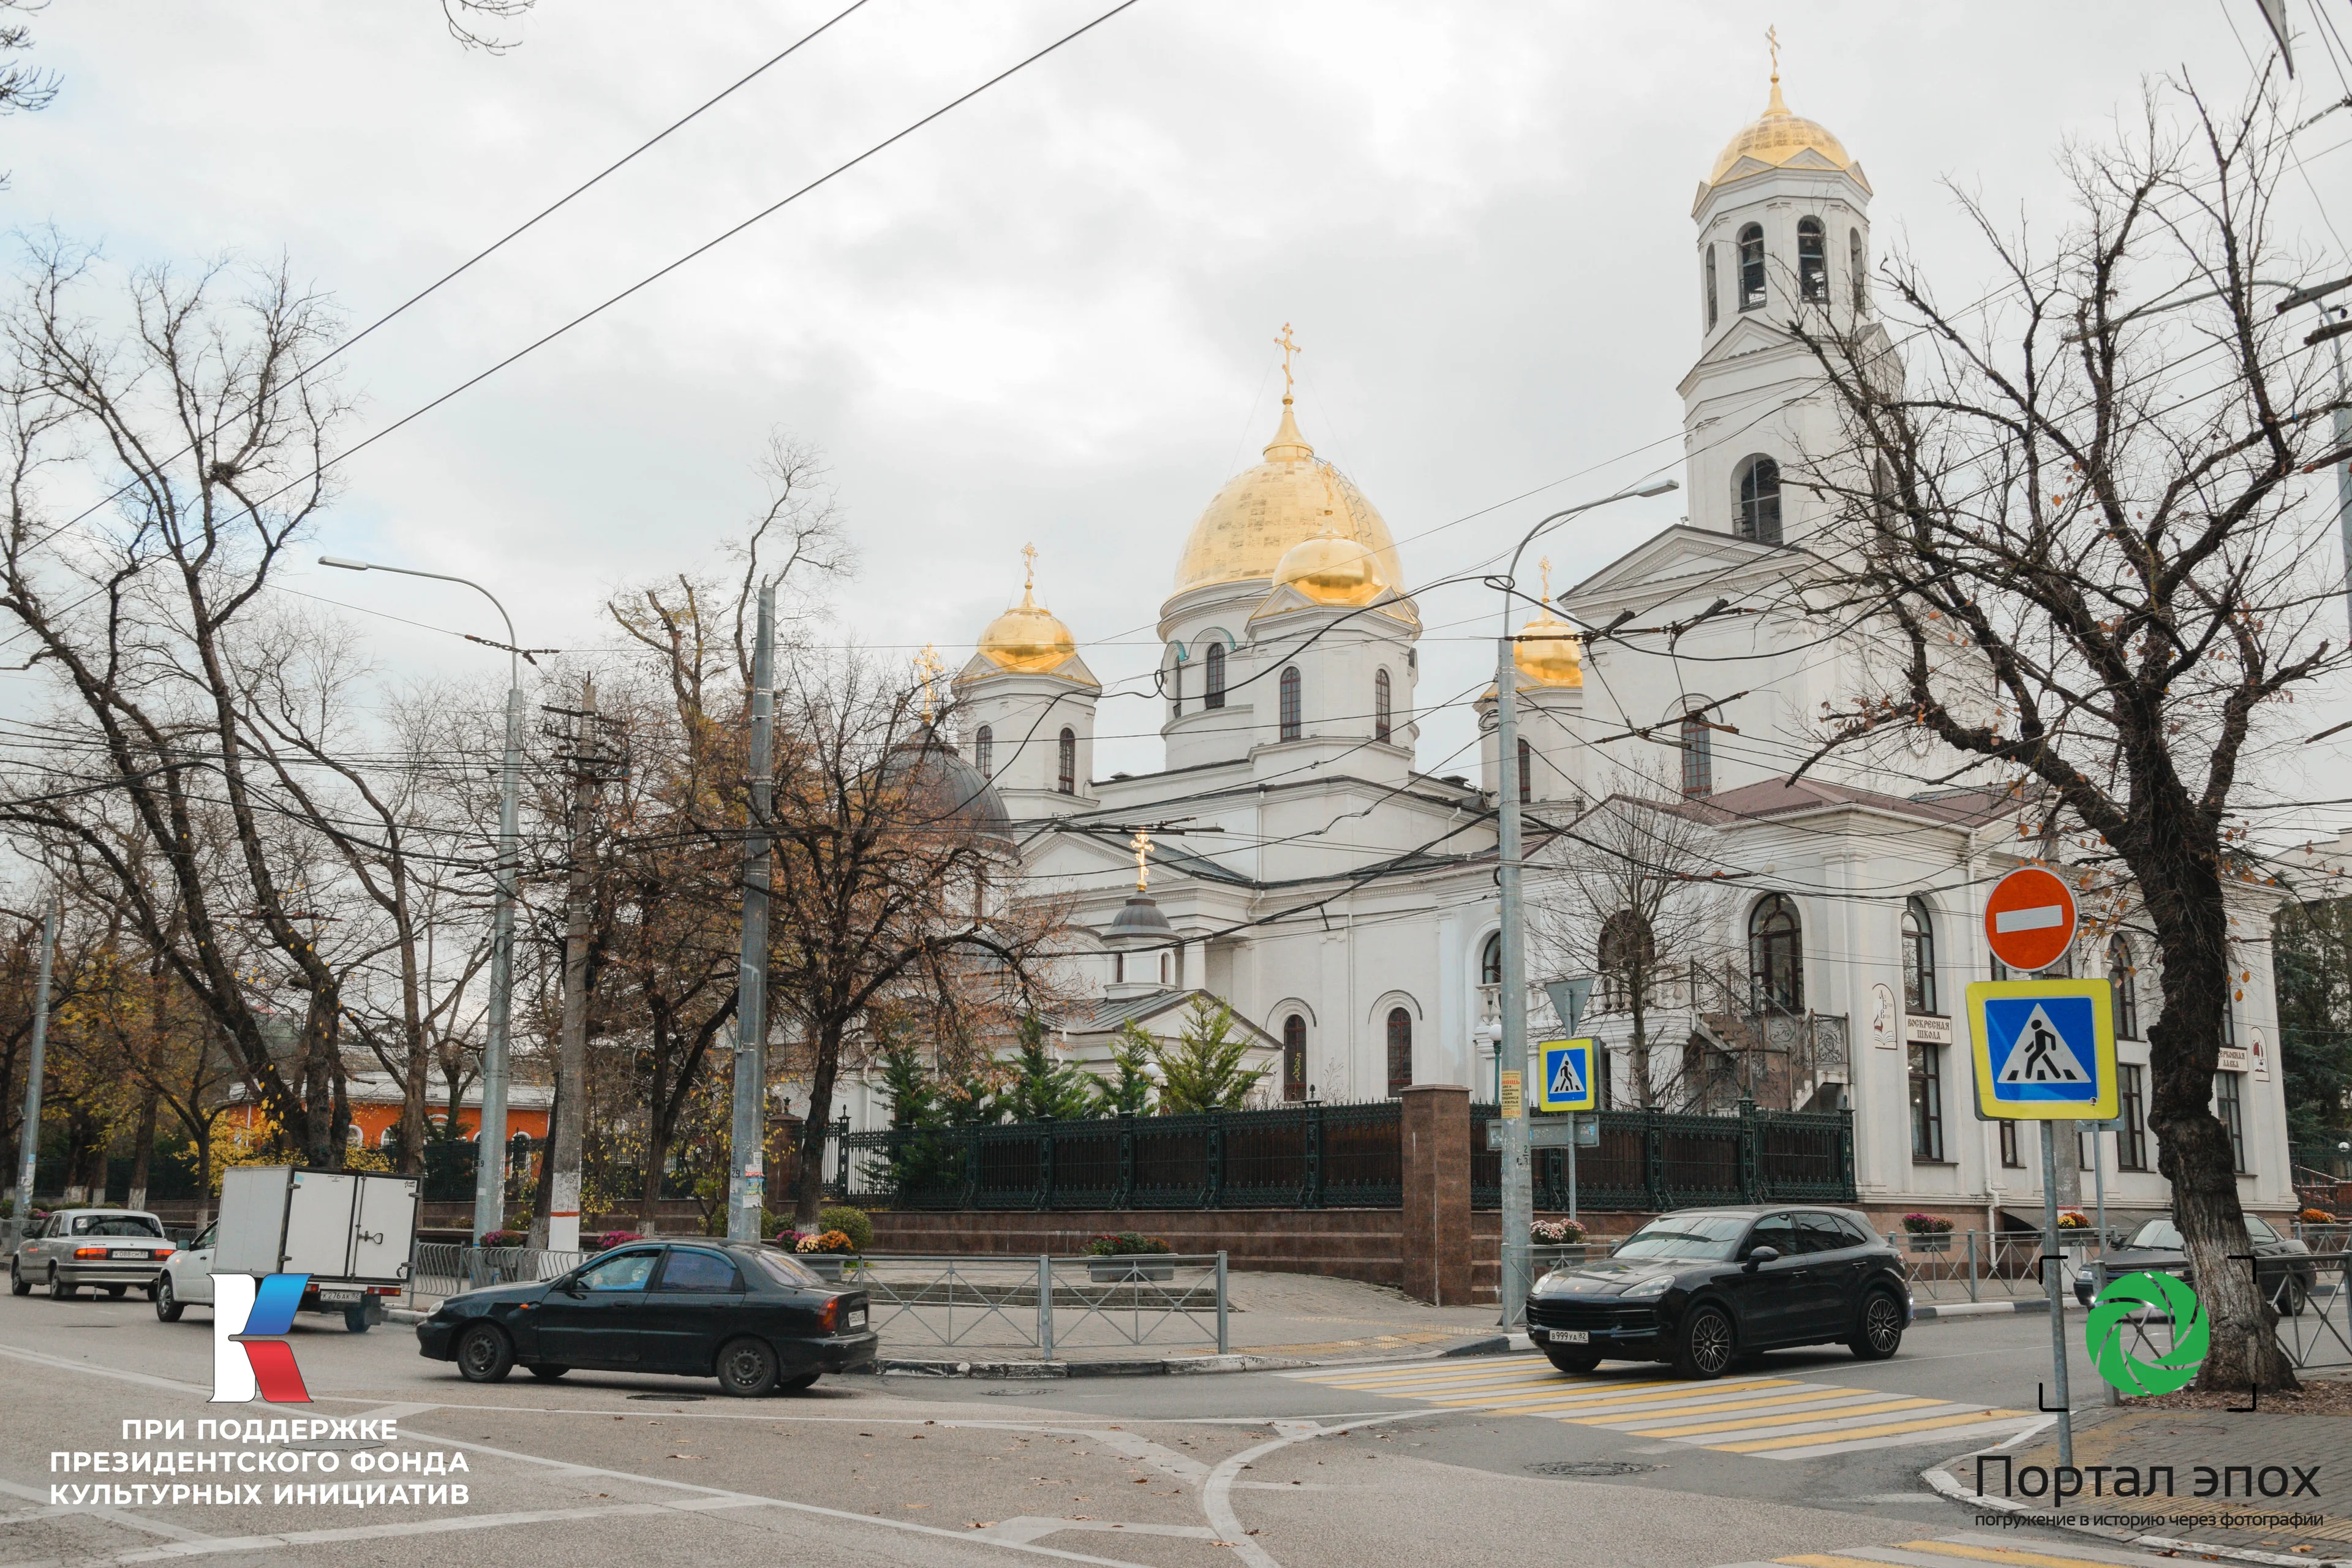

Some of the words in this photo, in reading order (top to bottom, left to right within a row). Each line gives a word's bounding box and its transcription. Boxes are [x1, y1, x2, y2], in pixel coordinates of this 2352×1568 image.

[1908, 1018, 1950, 1031] ВОСКРЕСНАЯ
[1917, 1030, 1941, 1040] ШКОЛА
[2218, 1050, 2245, 1060] ЕРКОВНАЯ
[2223, 1059, 2239, 1068] ЛАВКА
[731, 1169, 741, 1178] 29
[77, 1219, 86, 1228] Z
